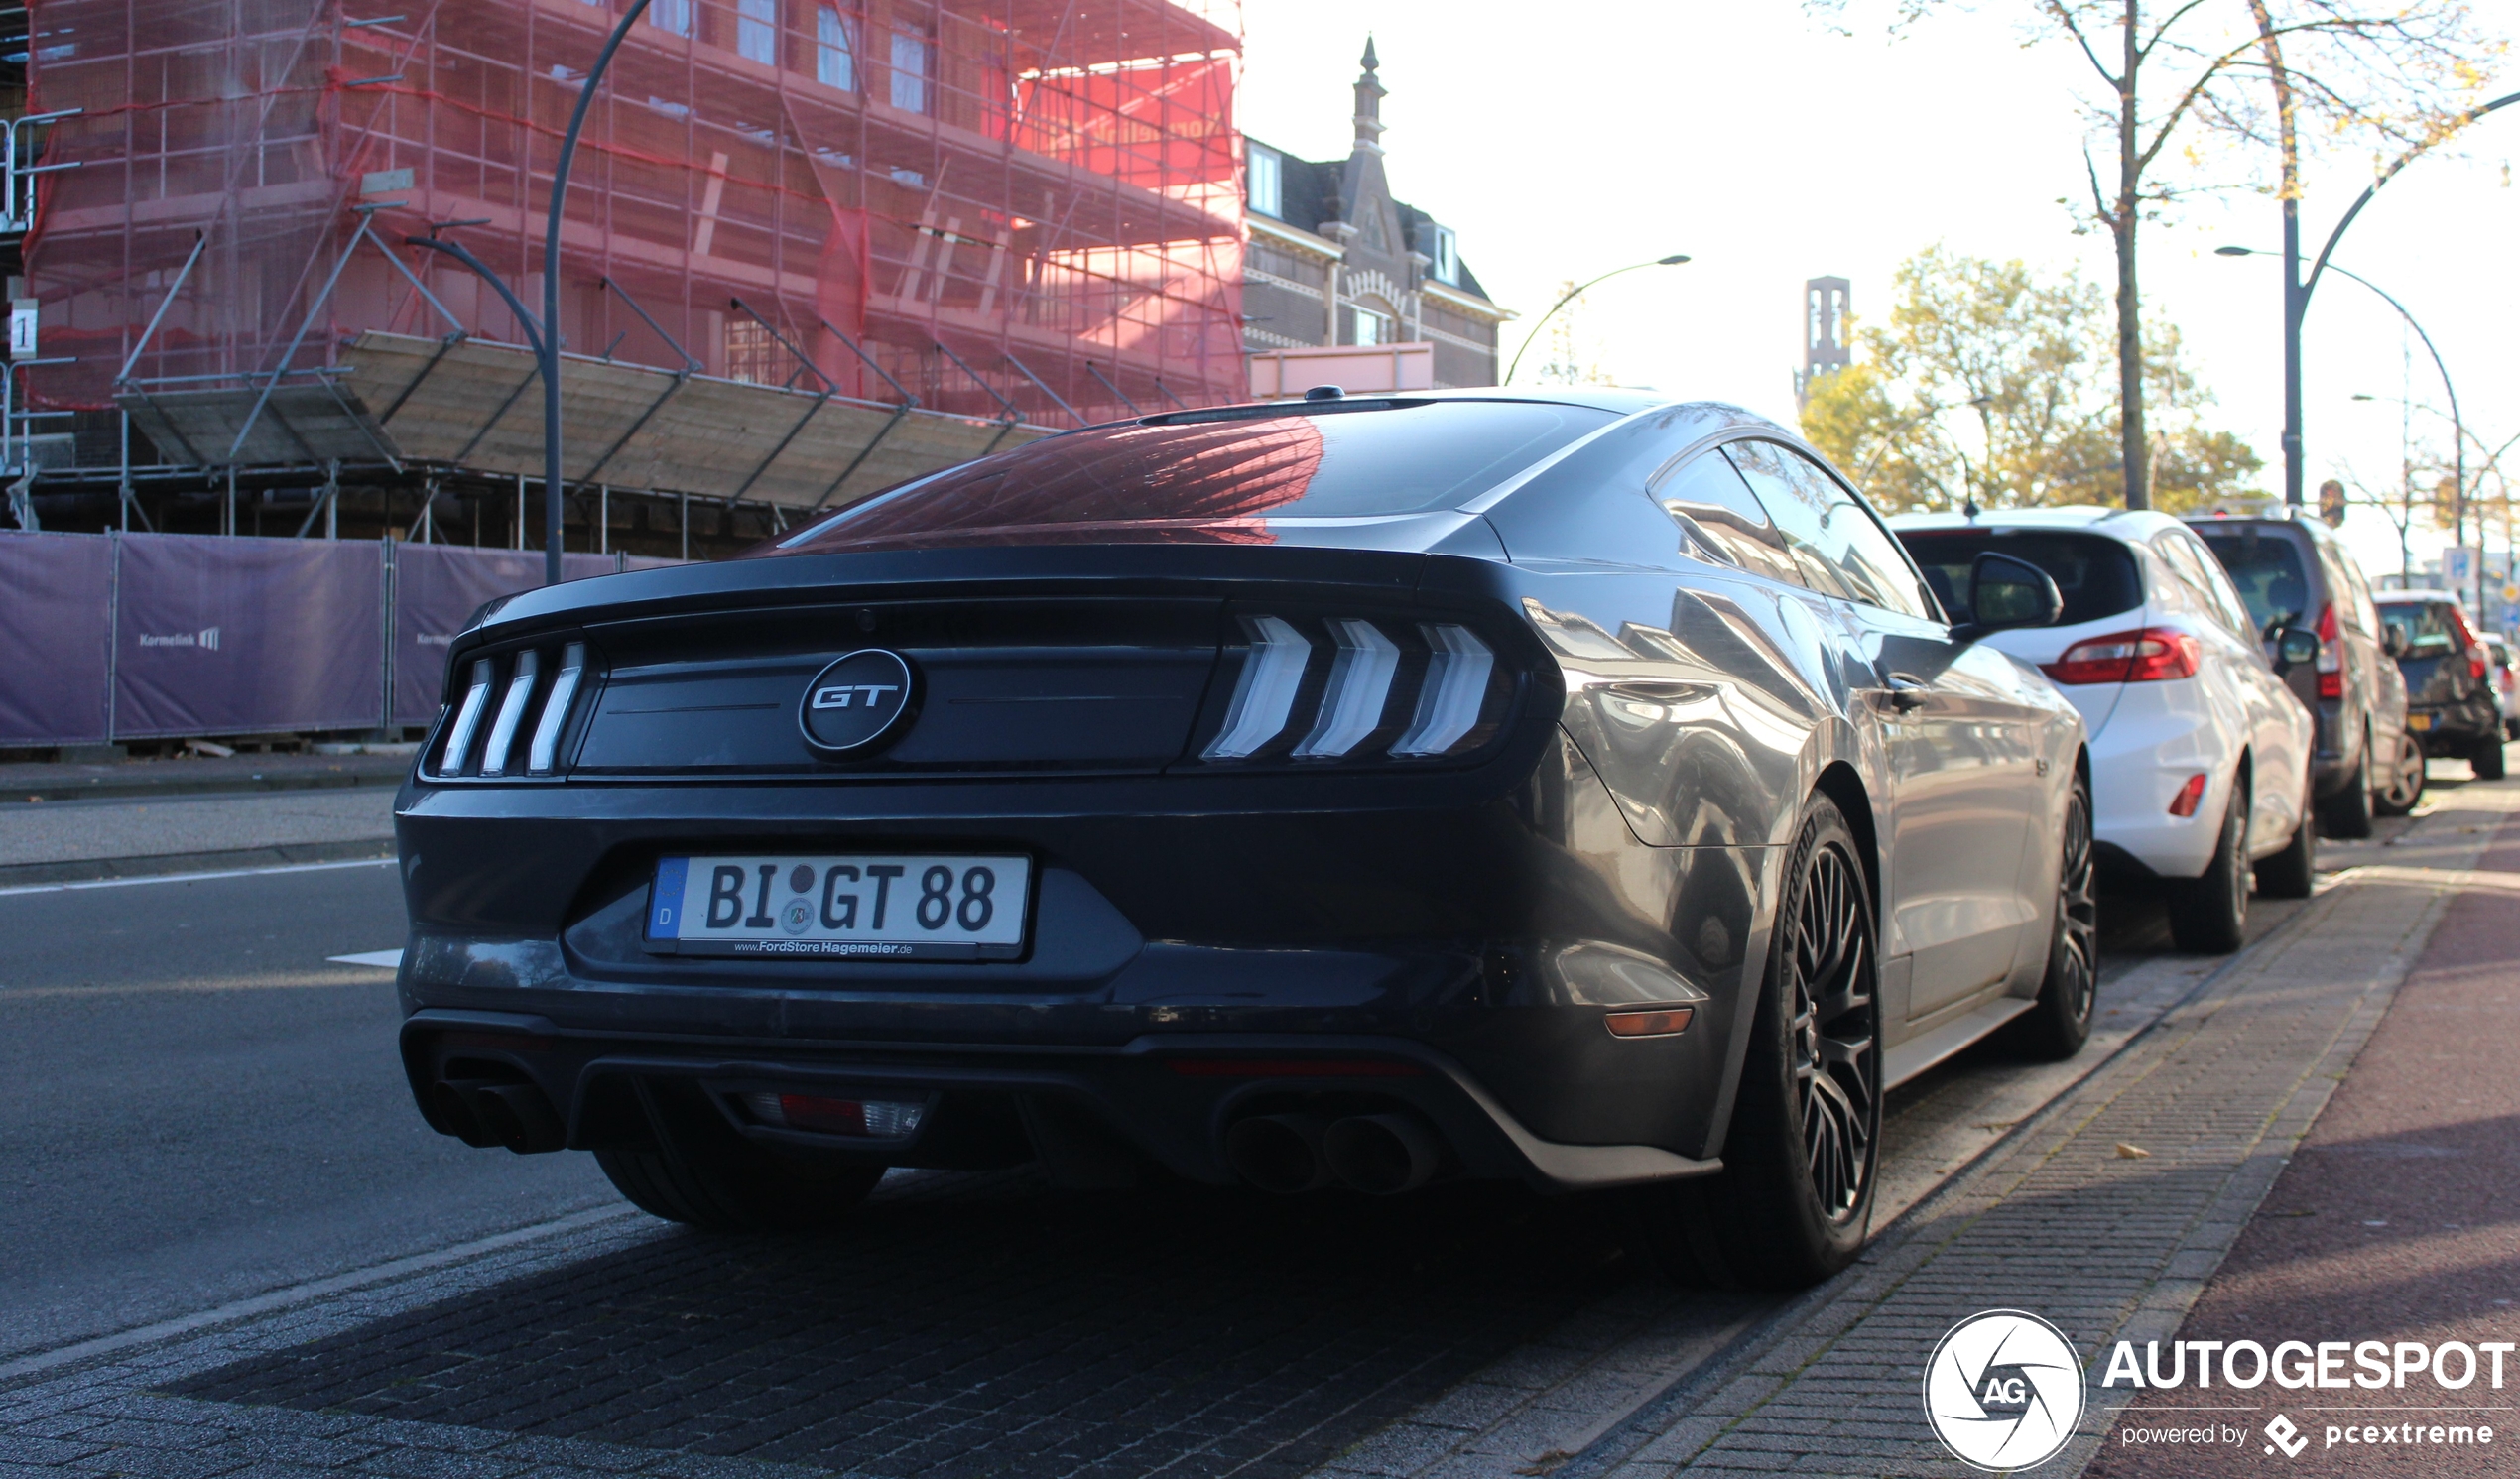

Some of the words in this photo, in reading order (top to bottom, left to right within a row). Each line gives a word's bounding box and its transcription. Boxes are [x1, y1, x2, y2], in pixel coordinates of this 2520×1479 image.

[16, 316, 30, 348] 1
[140, 633, 195, 647] Kormelink
[812, 684, 899, 709] GT
[706, 864, 778, 929] BI
[820, 864, 905, 930] GT
[916, 865, 995, 932] 88
[659, 908, 672, 925] D
